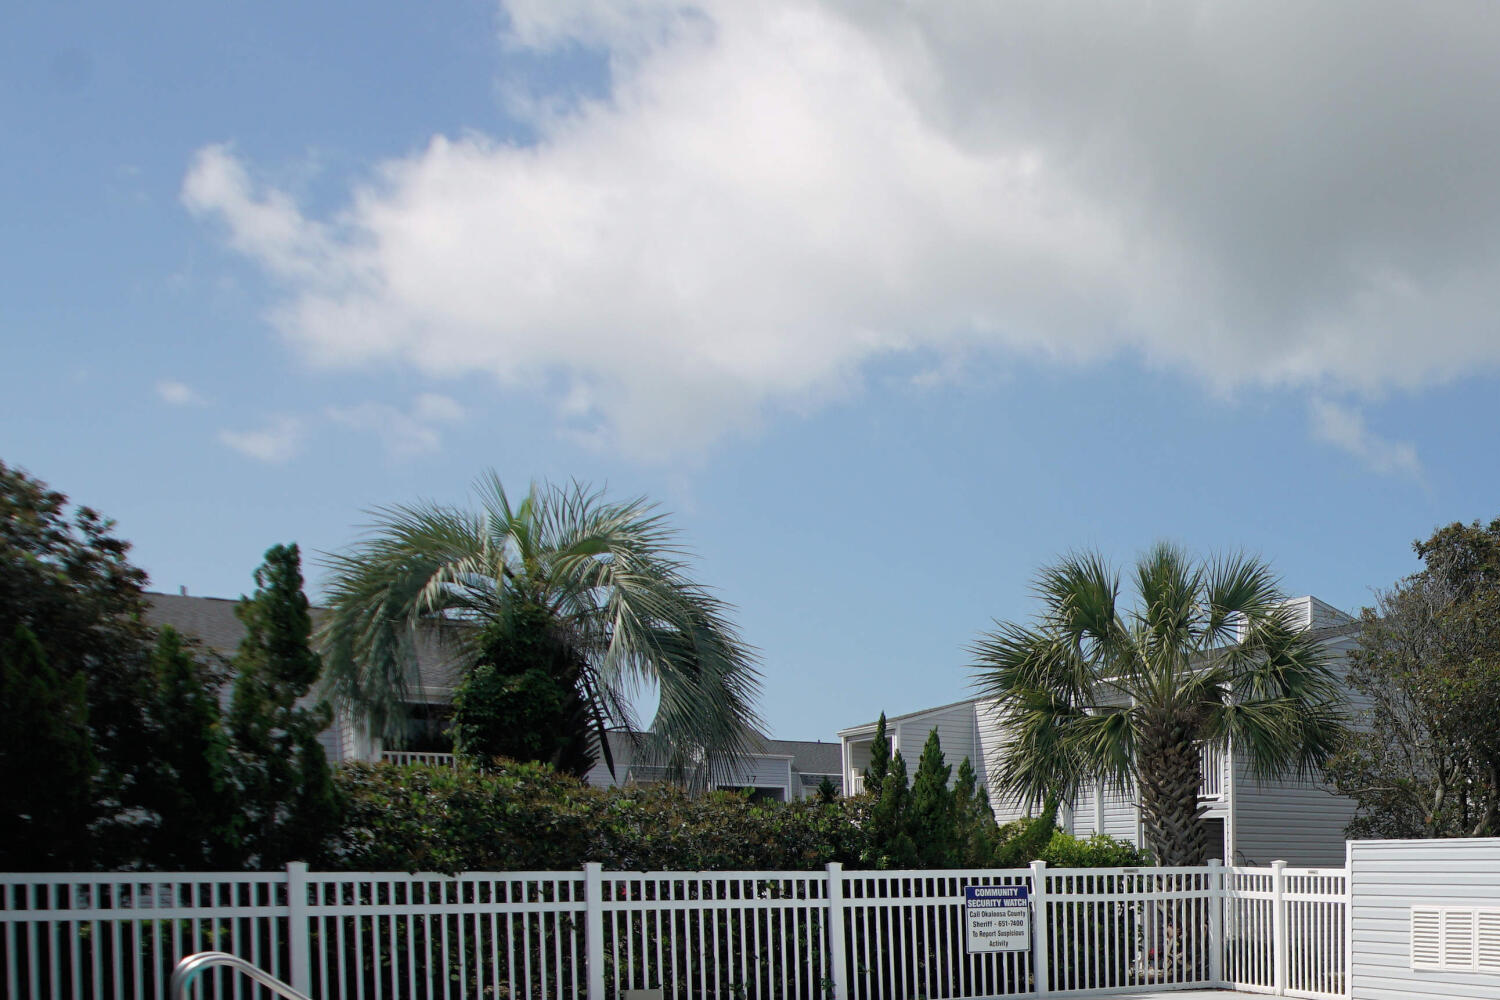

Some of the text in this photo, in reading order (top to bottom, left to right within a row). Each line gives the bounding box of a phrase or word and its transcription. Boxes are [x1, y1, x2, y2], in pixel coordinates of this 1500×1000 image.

[974, 888, 1019, 897] COMMUNITY
[967, 898, 1027, 908] SECURITY WATCH
[1007, 910, 1026, 919] County
[972, 920, 993, 928] Sheriff
[998, 919, 1024, 928] 651-7400
[979, 930, 997, 938] Report
[997, 930, 1025, 938] Suspicious
[989, 940, 1009, 948] Activity
